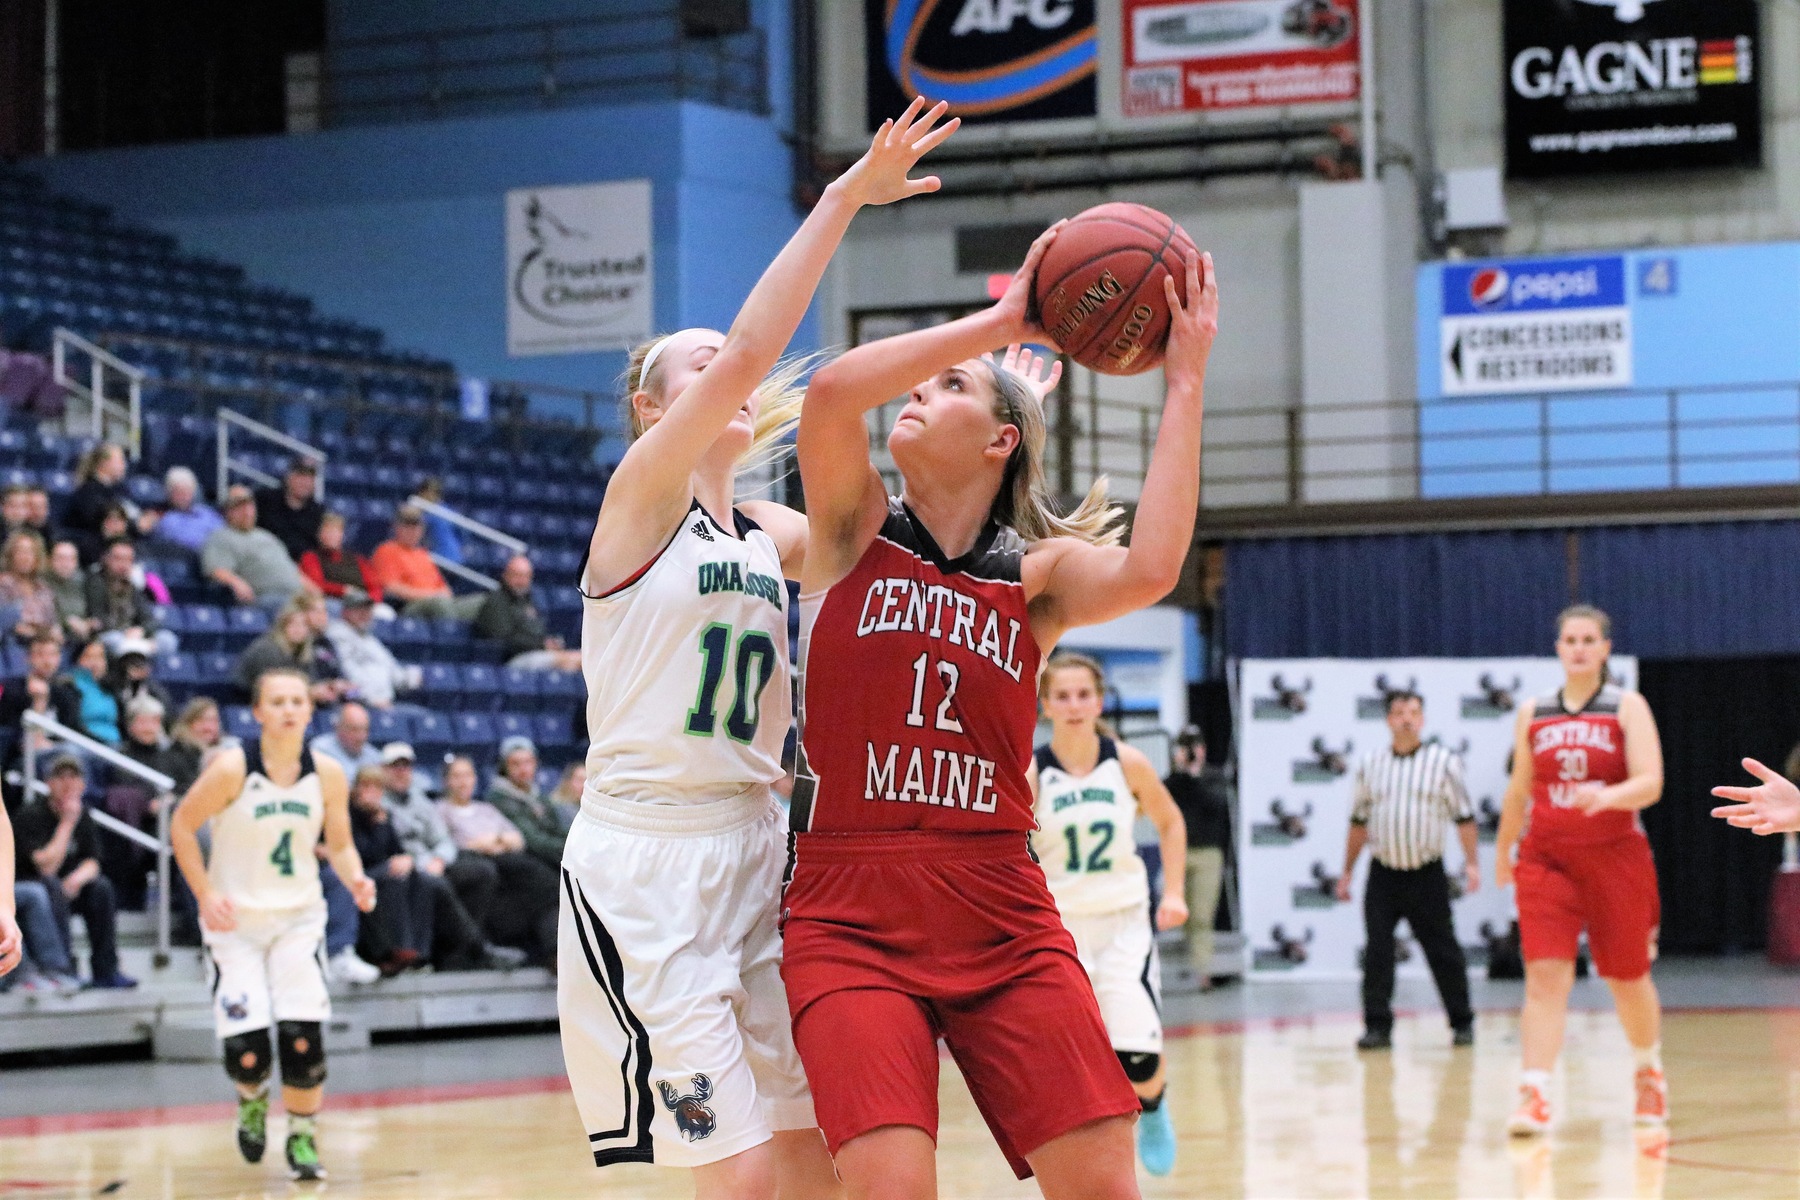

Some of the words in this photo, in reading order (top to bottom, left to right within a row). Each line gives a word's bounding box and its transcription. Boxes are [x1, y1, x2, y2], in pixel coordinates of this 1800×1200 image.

[1511, 37, 1698, 98] GAGNE
[544, 254, 645, 278] Trusted
[1512, 266, 1599, 306] pepsi
[543, 283, 632, 306] Choice
[1050, 268, 1125, 346] PALDING
[1464, 320, 1623, 350] CONCESSIONS
[1477, 351, 1614, 381] RESTROOMS
[690, 527, 715, 542] adidas
[698, 561, 744, 596] UMA
[857, 577, 1024, 683] CENTRAL
[683, 621, 777, 746] 10
[905, 651, 964, 735] 12
[1533, 720, 1616, 755] CENTRAL
[864, 740, 999, 815] MAINE
[1554, 748, 1588, 781] 30
[270, 829, 294, 876] 4
[1063, 819, 1116, 874] 12
